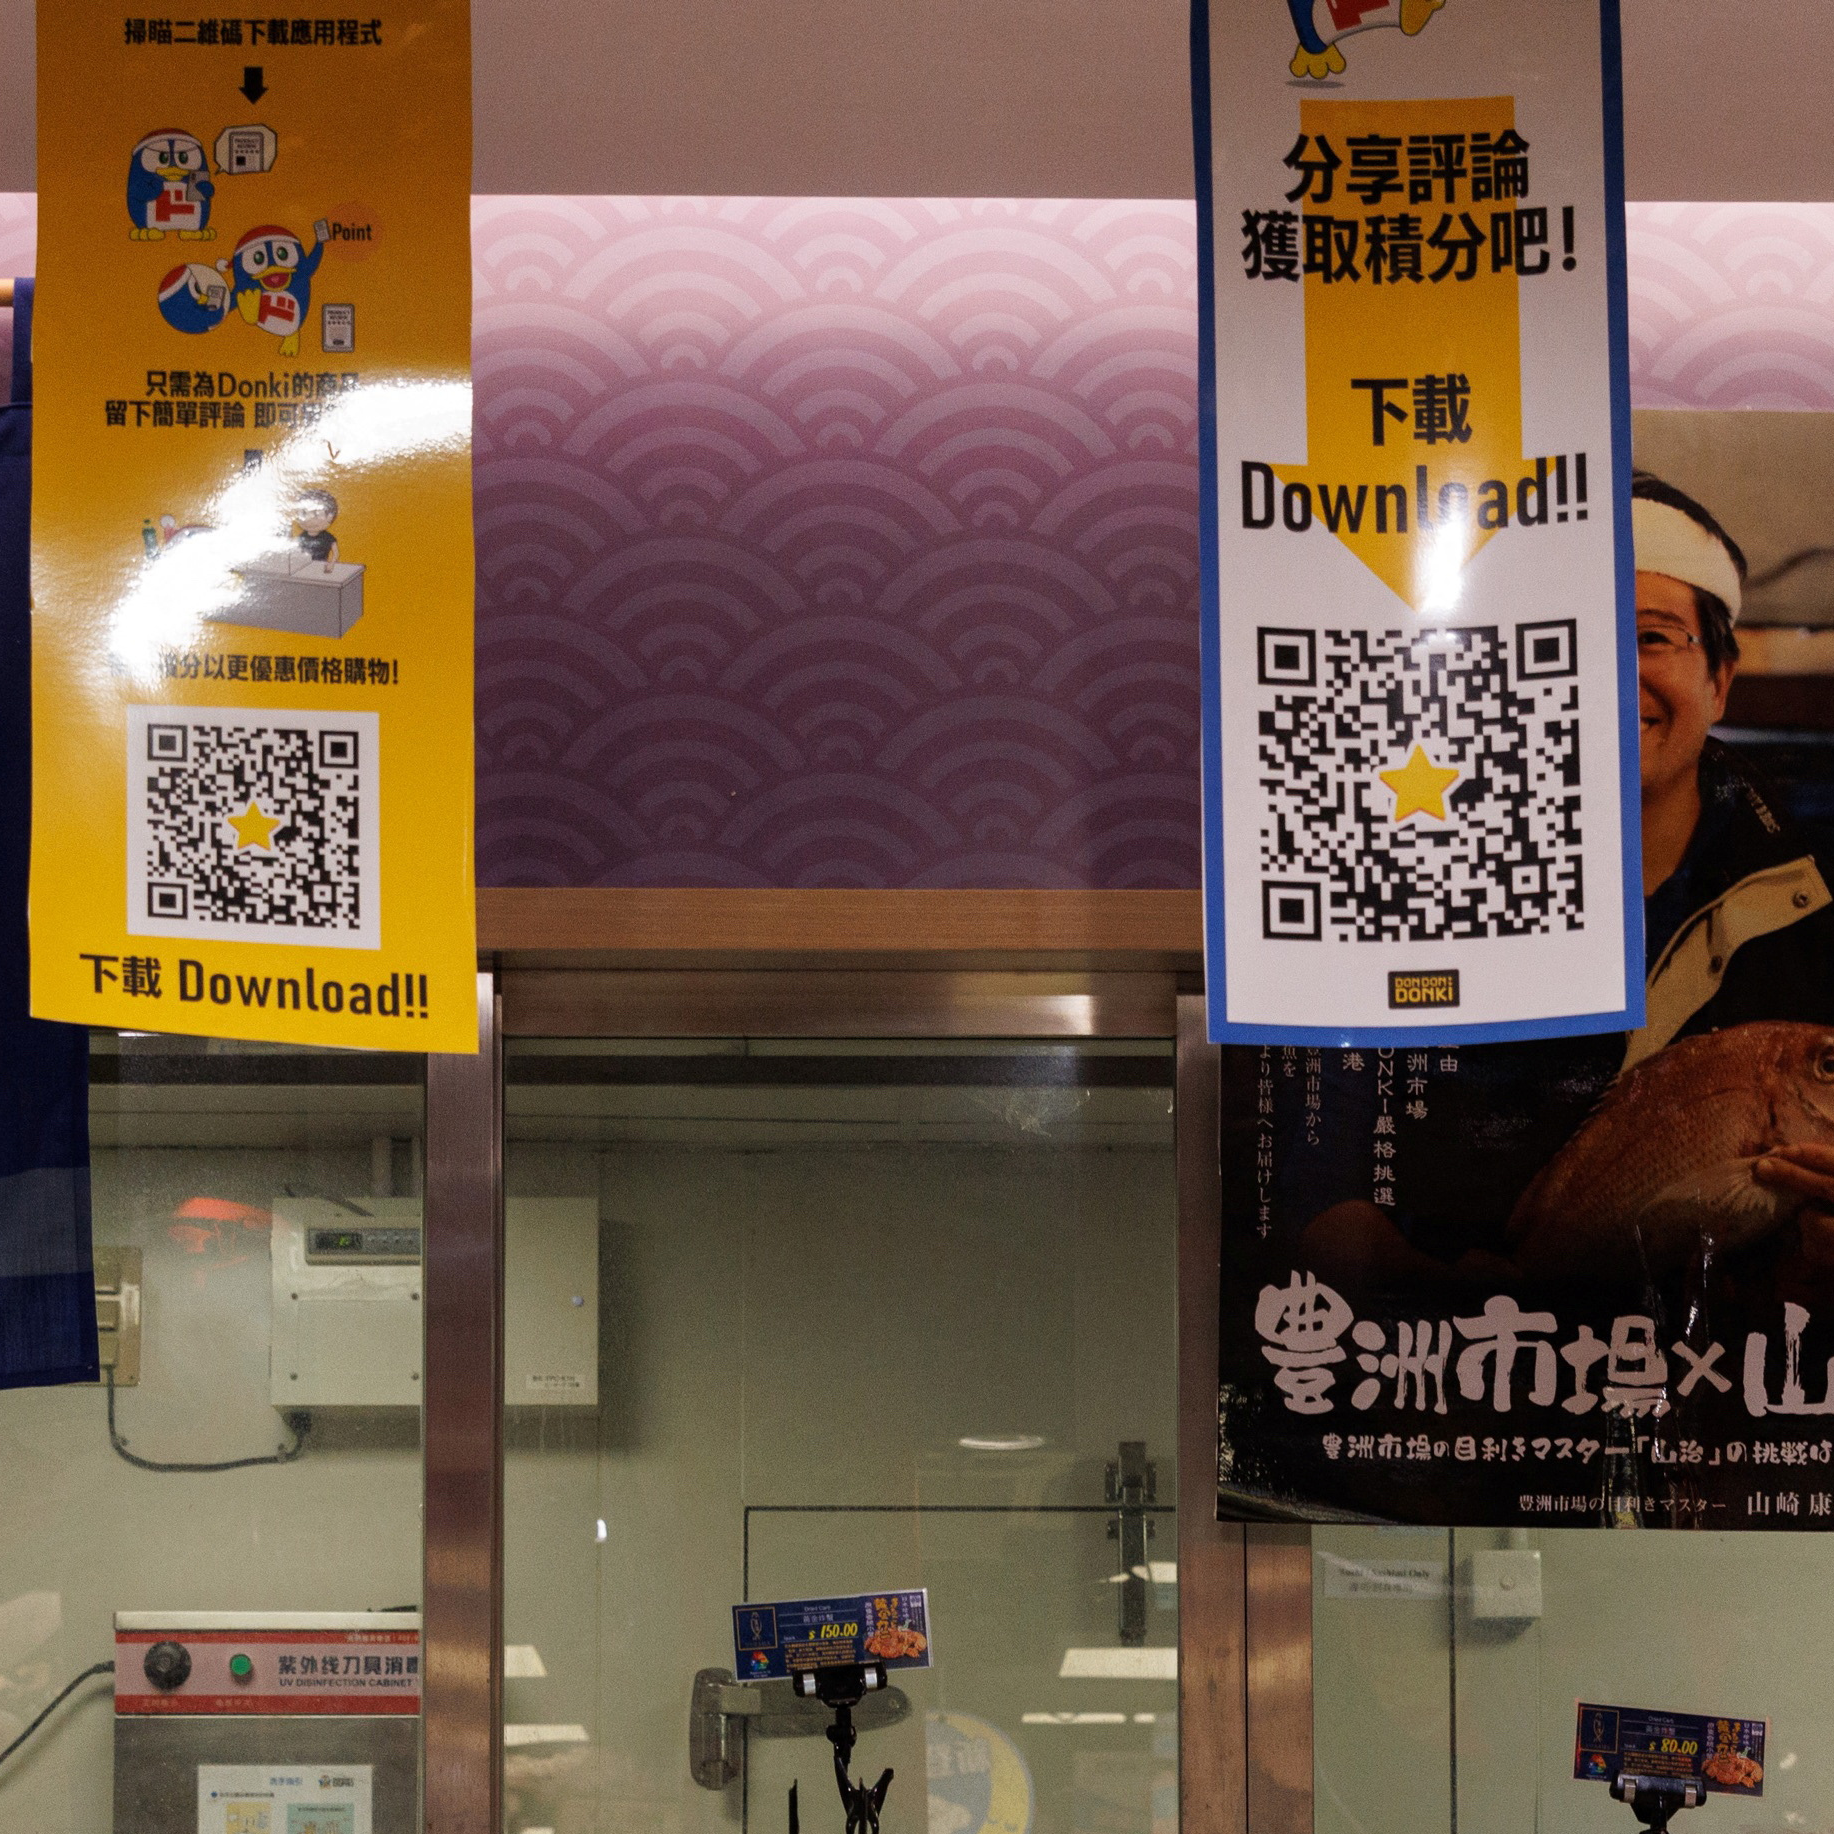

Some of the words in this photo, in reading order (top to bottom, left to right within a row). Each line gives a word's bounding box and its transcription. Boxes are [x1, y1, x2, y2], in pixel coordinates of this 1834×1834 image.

[125, 19, 382, 46] 掃瞄二維碼下載應用程式
[1283, 129, 1530, 205] 分享評論
[333, 222, 372, 243] Point
[1241, 206, 1577, 284] 獲取積分吧!
[105, 401, 245, 427] 留下簡單評論
[1351, 374, 1472, 447] 下載
[1241, 453, 1588, 534] Download!!
[80, 954, 161, 998] 下載
[180, 960, 429, 1019] Download!!
[821, 1624, 858, 1638] 150.00
[279, 1679, 293, 1687] UV
[296, 1679, 366, 1687] DISINFECTION
[369, 1679, 412, 1687] CABINET
[1660, 1737, 1698, 1755] 80.00
